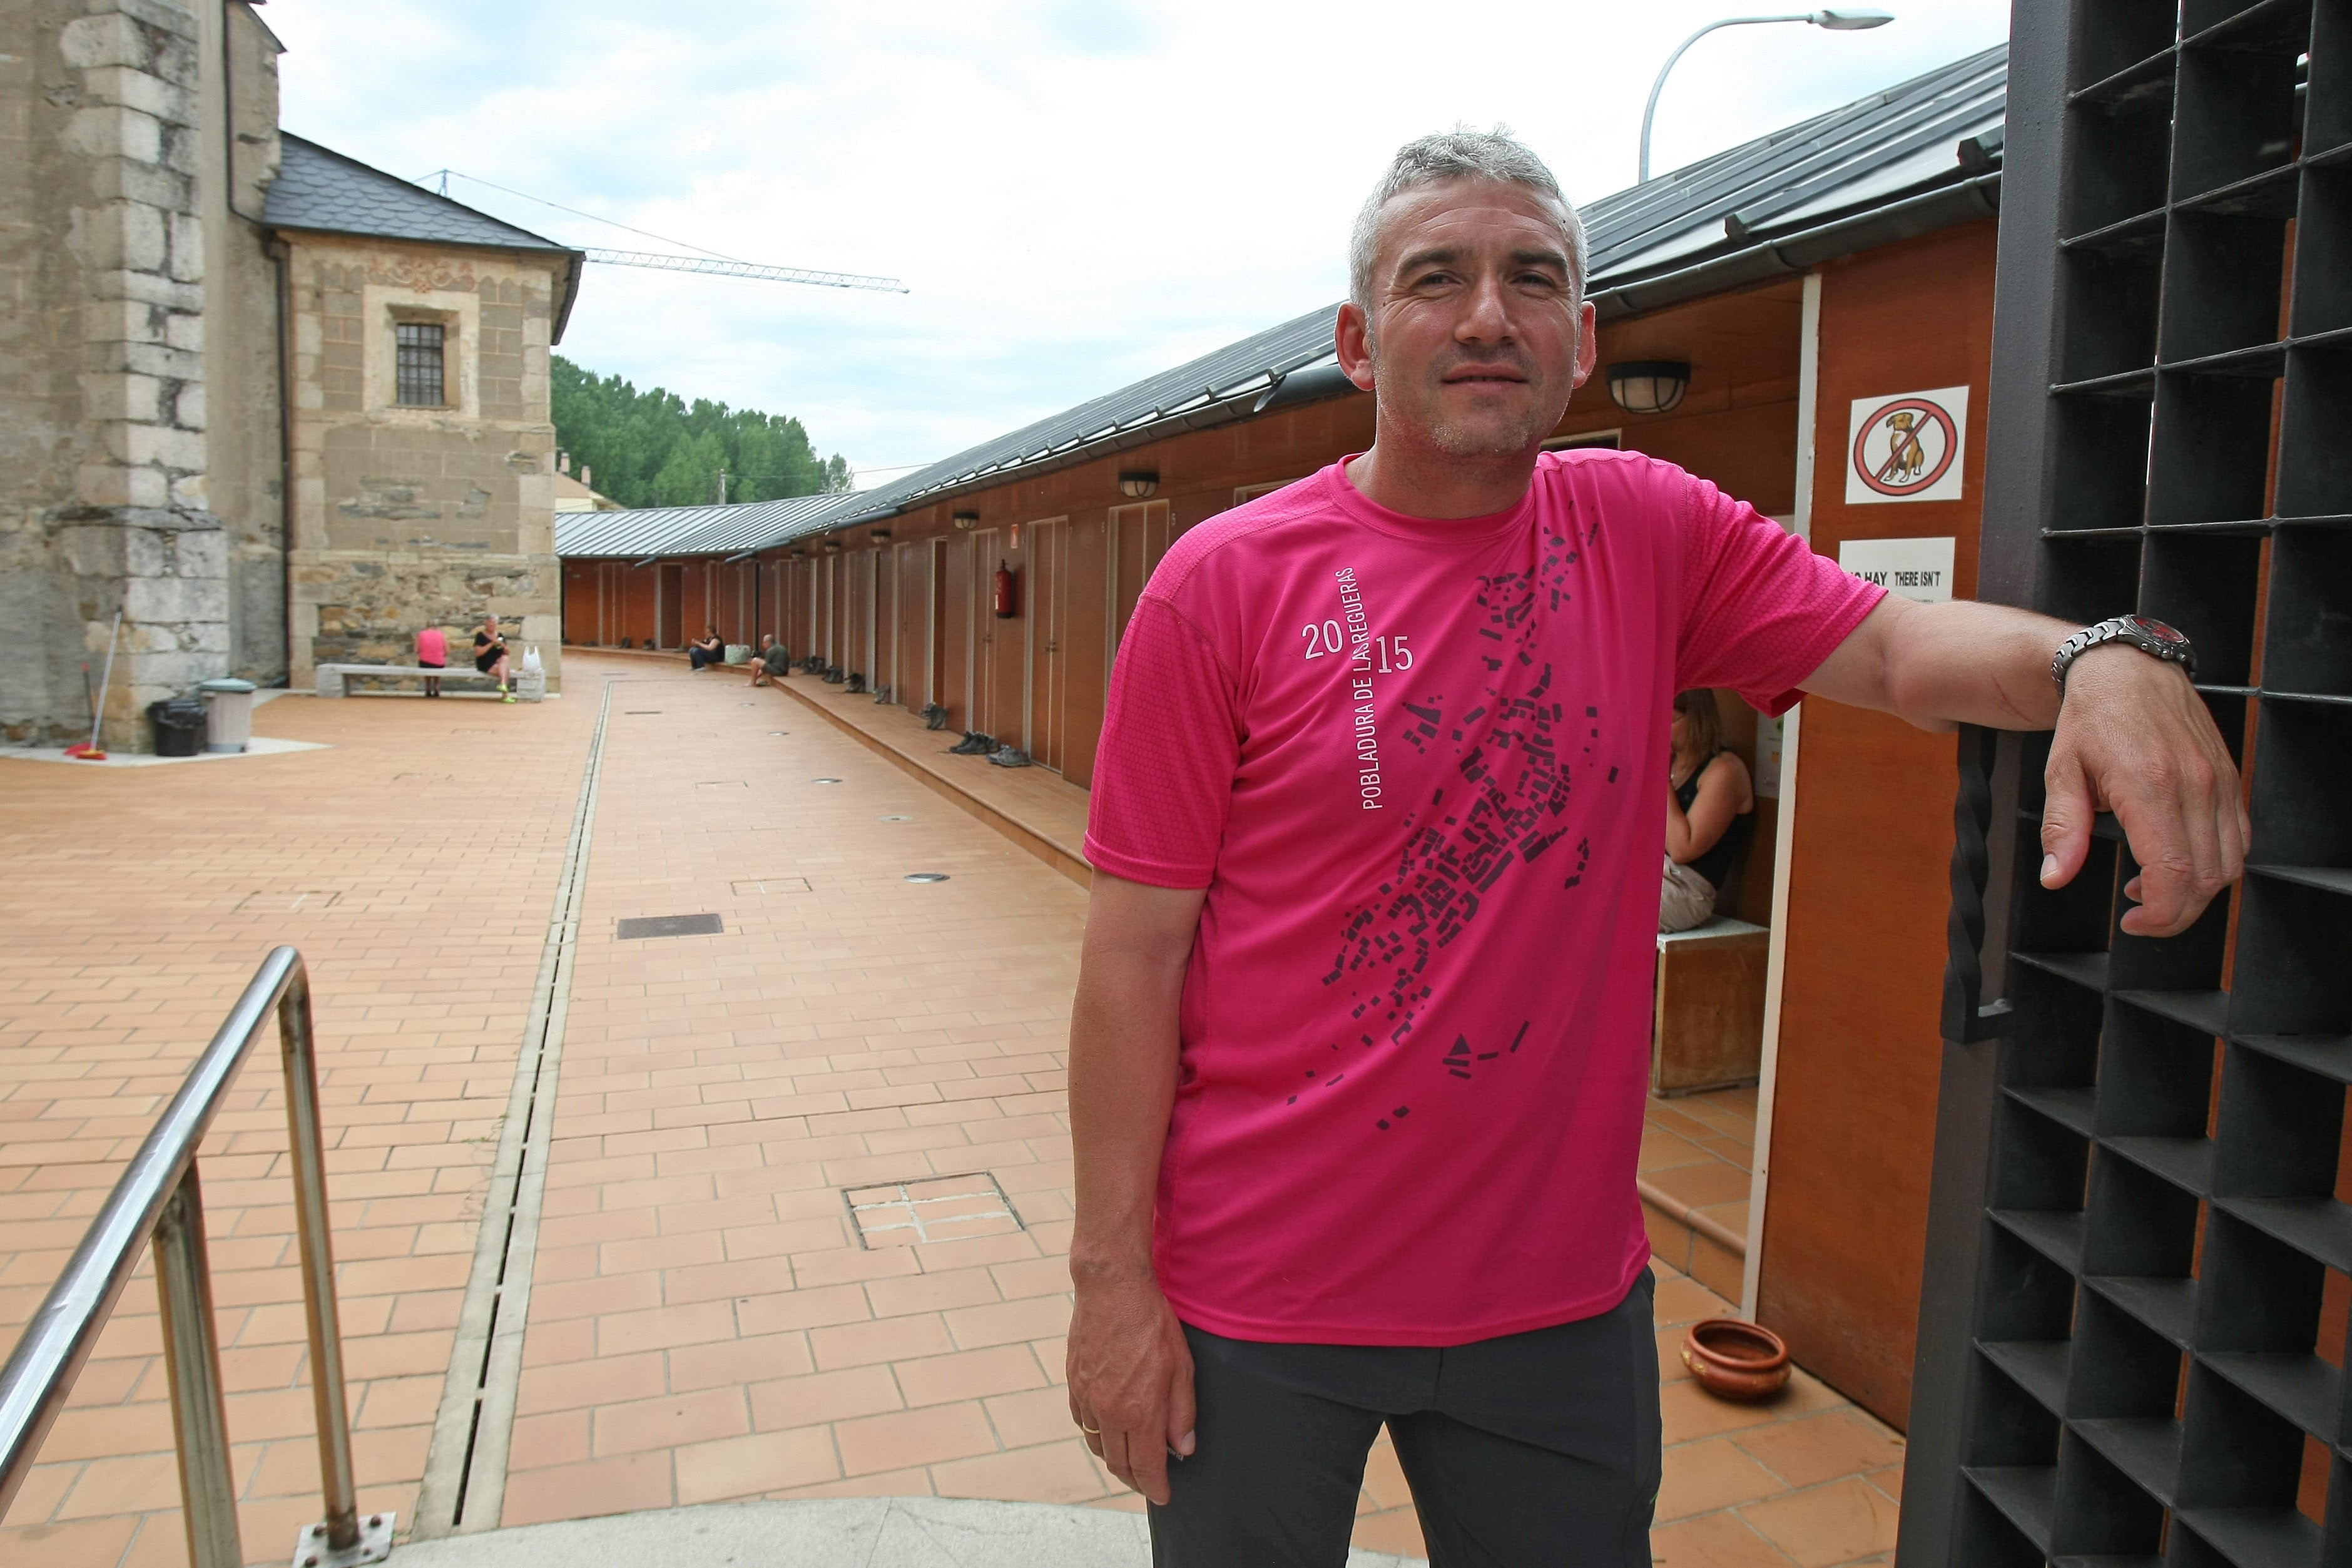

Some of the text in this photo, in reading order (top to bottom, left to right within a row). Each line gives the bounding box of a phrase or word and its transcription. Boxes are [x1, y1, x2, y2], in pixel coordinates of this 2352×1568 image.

[1335, 567, 1370, 644] REGUERAS
[1865, 571, 1887, 586] HAY
[1895, 571, 1918, 586] THERE
[1301, 619, 1414, 674] 20 15
[1352, 676, 1374, 700] DE
[1354, 703, 1383, 810] POBLADURA
